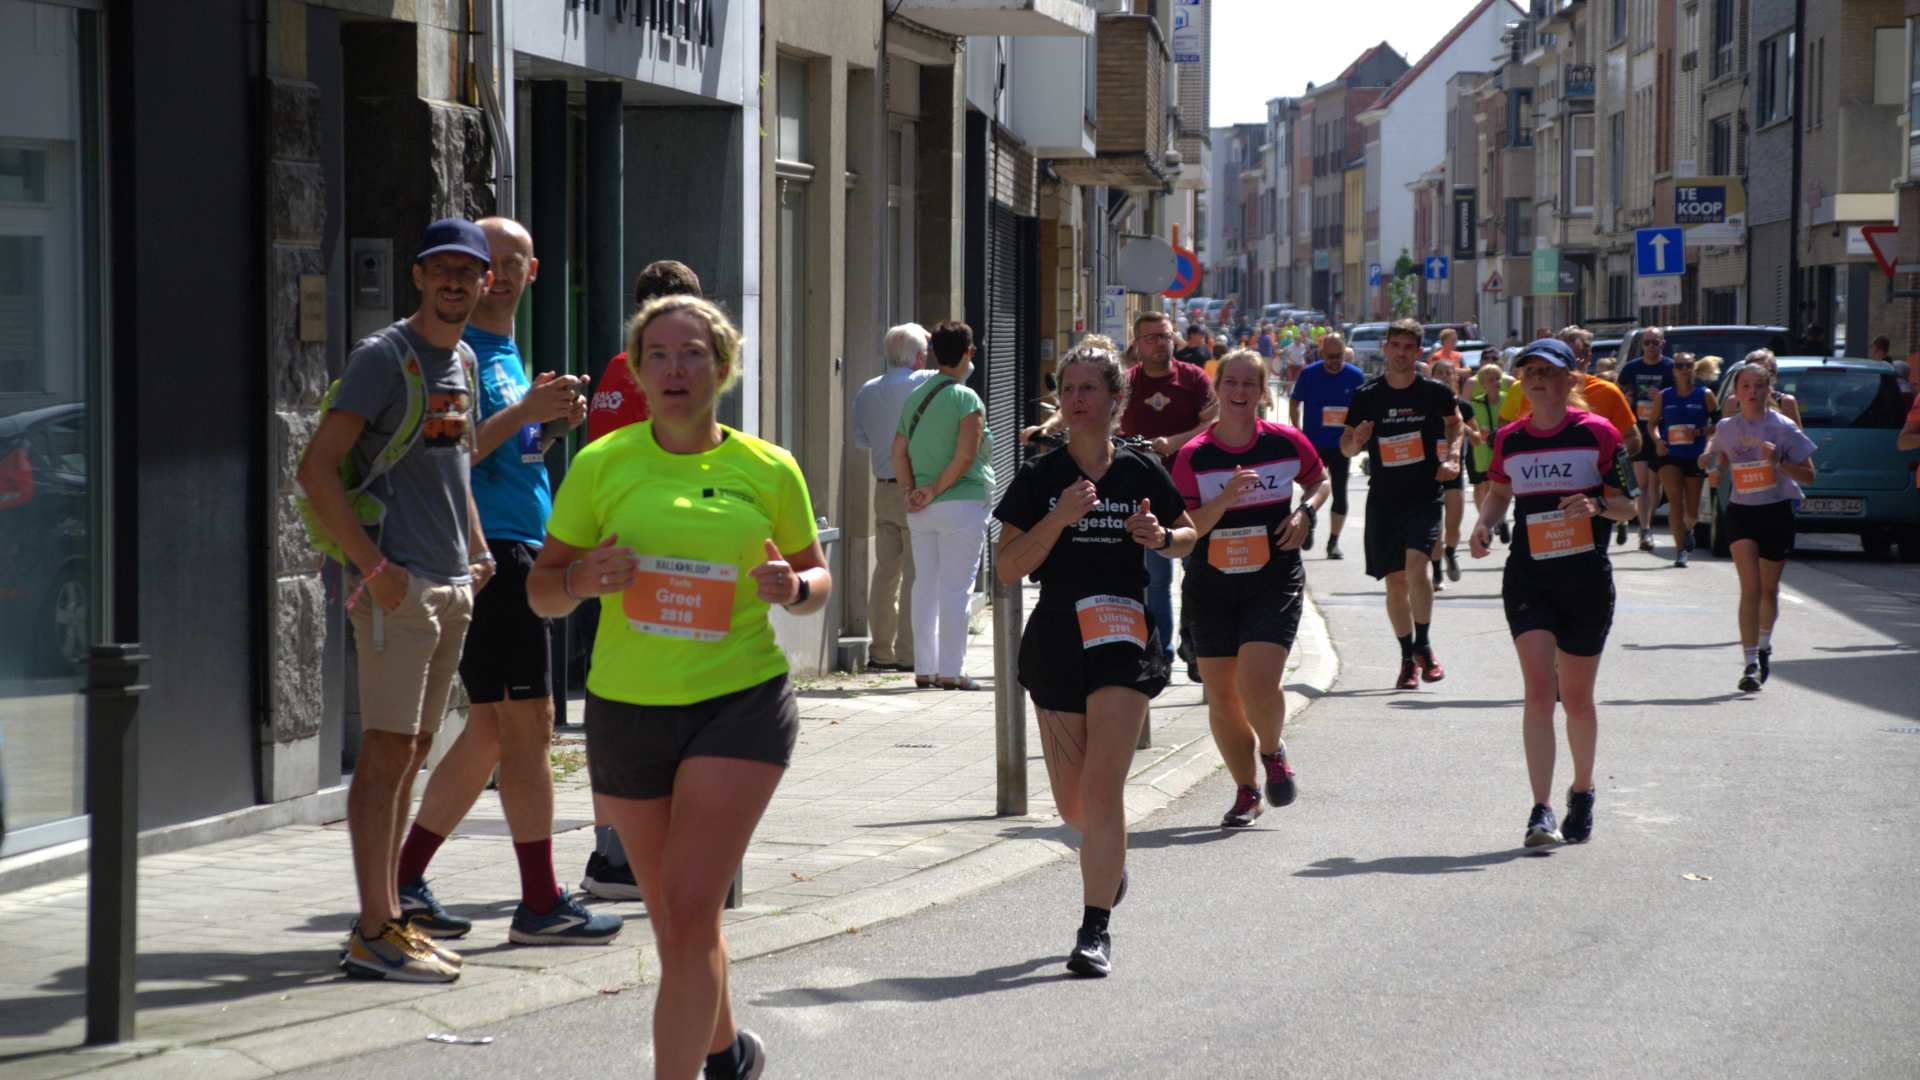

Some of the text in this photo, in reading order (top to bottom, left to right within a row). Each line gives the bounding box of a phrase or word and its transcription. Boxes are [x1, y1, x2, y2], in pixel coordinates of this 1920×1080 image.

[1679, 188, 1697, 200] TE
[1678, 202, 1723, 215] KOOP
[656, 588, 702, 608] Greet
